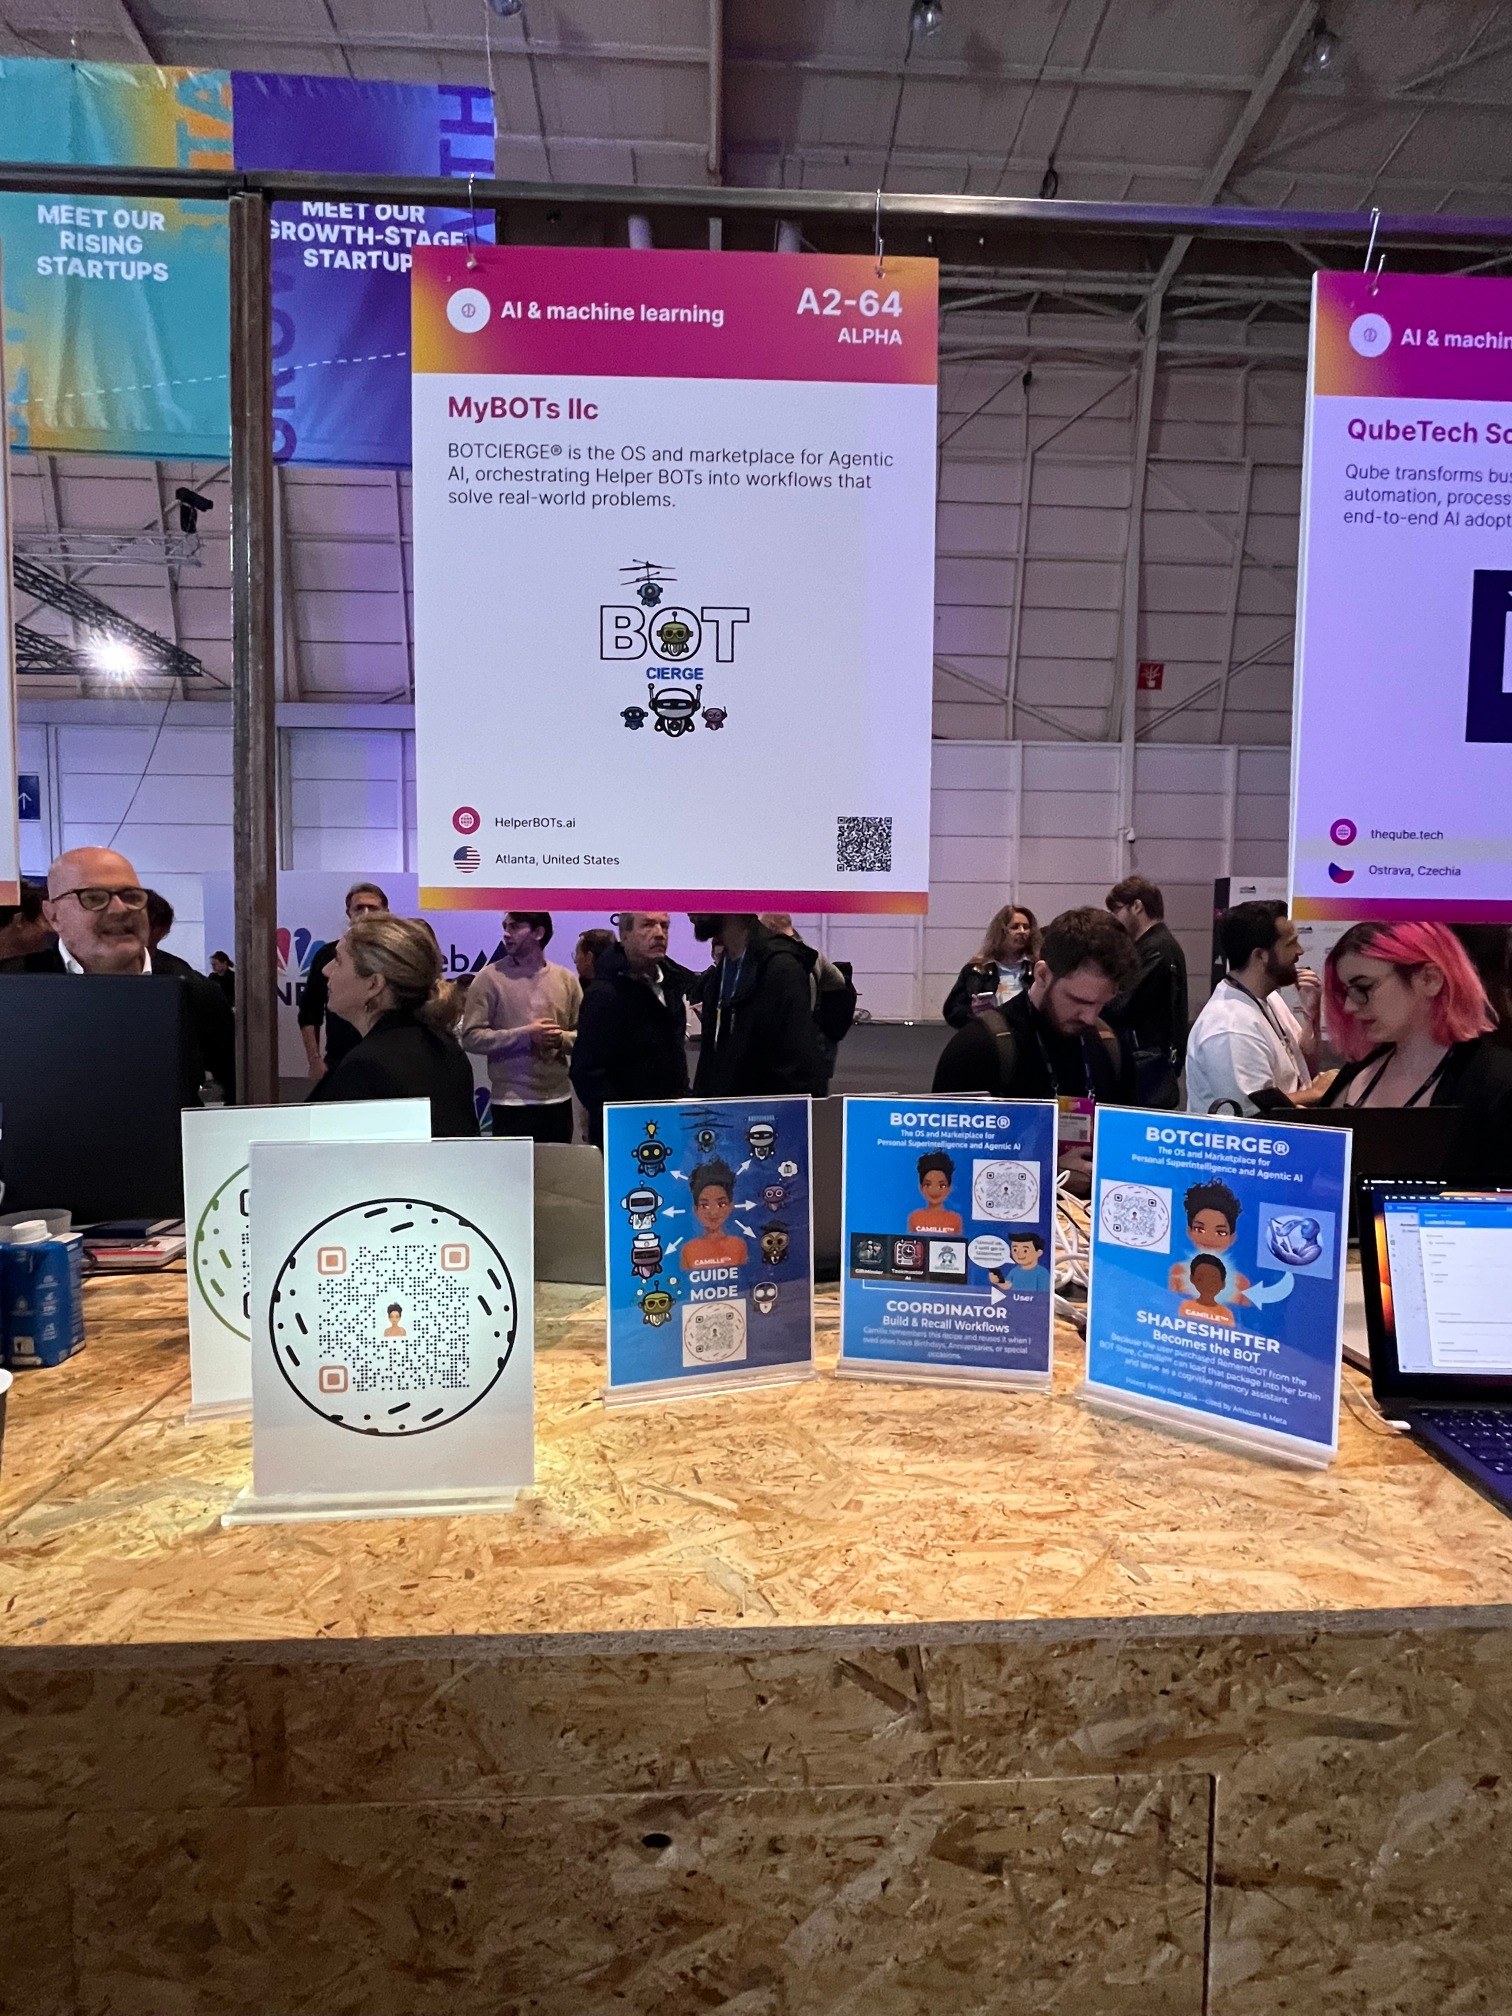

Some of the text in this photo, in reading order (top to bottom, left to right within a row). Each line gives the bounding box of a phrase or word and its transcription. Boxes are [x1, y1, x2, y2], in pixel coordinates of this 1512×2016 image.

[37, 204, 165, 231] MEET OUR
[302, 201, 425, 223] MEET OUR
[60, 230, 143, 255] RISING
[37, 256, 169, 282] STARTUPS
[304, 248, 412, 272] STARTUP
[797, 287, 902, 317] A2-64
[501, 302, 724, 327] AI & machine learning
[838, 327, 902, 345] ALPHA
[1401, 329, 1421, 345] AI
[1426, 330, 1439, 347] &
[448, 396, 560, 424] MyBOTs
[1347, 418, 1478, 443] QubeTech
[569, 444, 581, 461] is
[587, 444, 615, 461] the
[621, 445, 646, 462] OS
[652, 445, 684, 463] and
[689, 447, 794, 470] marketplace
[801, 448, 823, 466] for
[829, 449, 893, 472] Agentic
[448, 466, 871, 490] AI, orchestrating Helper BOTs into workflows that
[1345, 464, 1390, 480] Qube
[1396, 465, 1482, 482] transforms
[448, 489, 676, 511] solve real-world problems.
[1344, 488, 1442, 507] automation,
[1344, 510, 1437, 525] end-to-end
[1443, 512, 1460, 526] AI
[600, 605, 749, 662] BOT
[646, 667, 704, 680] CIERGE
[495, 816, 576, 831] HelperBOTs.ai
[1371, 829, 1443, 841] theqube.tech
[495, 853, 620, 867] Atlanta, United States
[1369, 865, 1461, 878] Ostrava, Czechia
[878, 1139, 907, 1147] Personal
[984, 1142, 1011, 1151] Agentic
[915, 1130, 925, 1138] OS
[926, 1130, 939, 1138] and
[941, 1131, 983, 1140] Marketplace
[1132, 1153, 1165, 1165] Personal
[1239, 1167, 1255, 1176] and
[1257, 1169, 1292, 1181] Agentic
[1158, 1146, 1271, 1167] The OS and Marketplace for
[689, 1267, 738, 1283] GUIDE
[690, 1285, 738, 1301] MODE
[1013, 1293, 1034, 1302] User
[886, 1300, 1007, 1319] COORDINATOR
[883, 1316, 1009, 1333] Build & Recall Workflows
[1136, 1310, 1280, 1353] SHAPESHIFTER
[1153, 1329, 1261, 1364] Becomes the BOT
[1189, 1363, 1206, 1374] load
[1208, 1367, 1225, 1378] that
[1226, 1372, 1261, 1387] package
[1262, 1381, 1279, 1391] into
[1281, 1384, 1296, 1395] her
[1298, 1388, 1321, 1401] brain
[1217, 1358, 1268, 1377] RememBOT
[1269, 1370, 1290, 1382] from
[1292, 1376, 1307, 1386] the
[1177, 1372, 1214, 1386] cognitive
[1215, 1381, 1249, 1396] memory
[1251, 1389, 1290, 1405] assistant.
